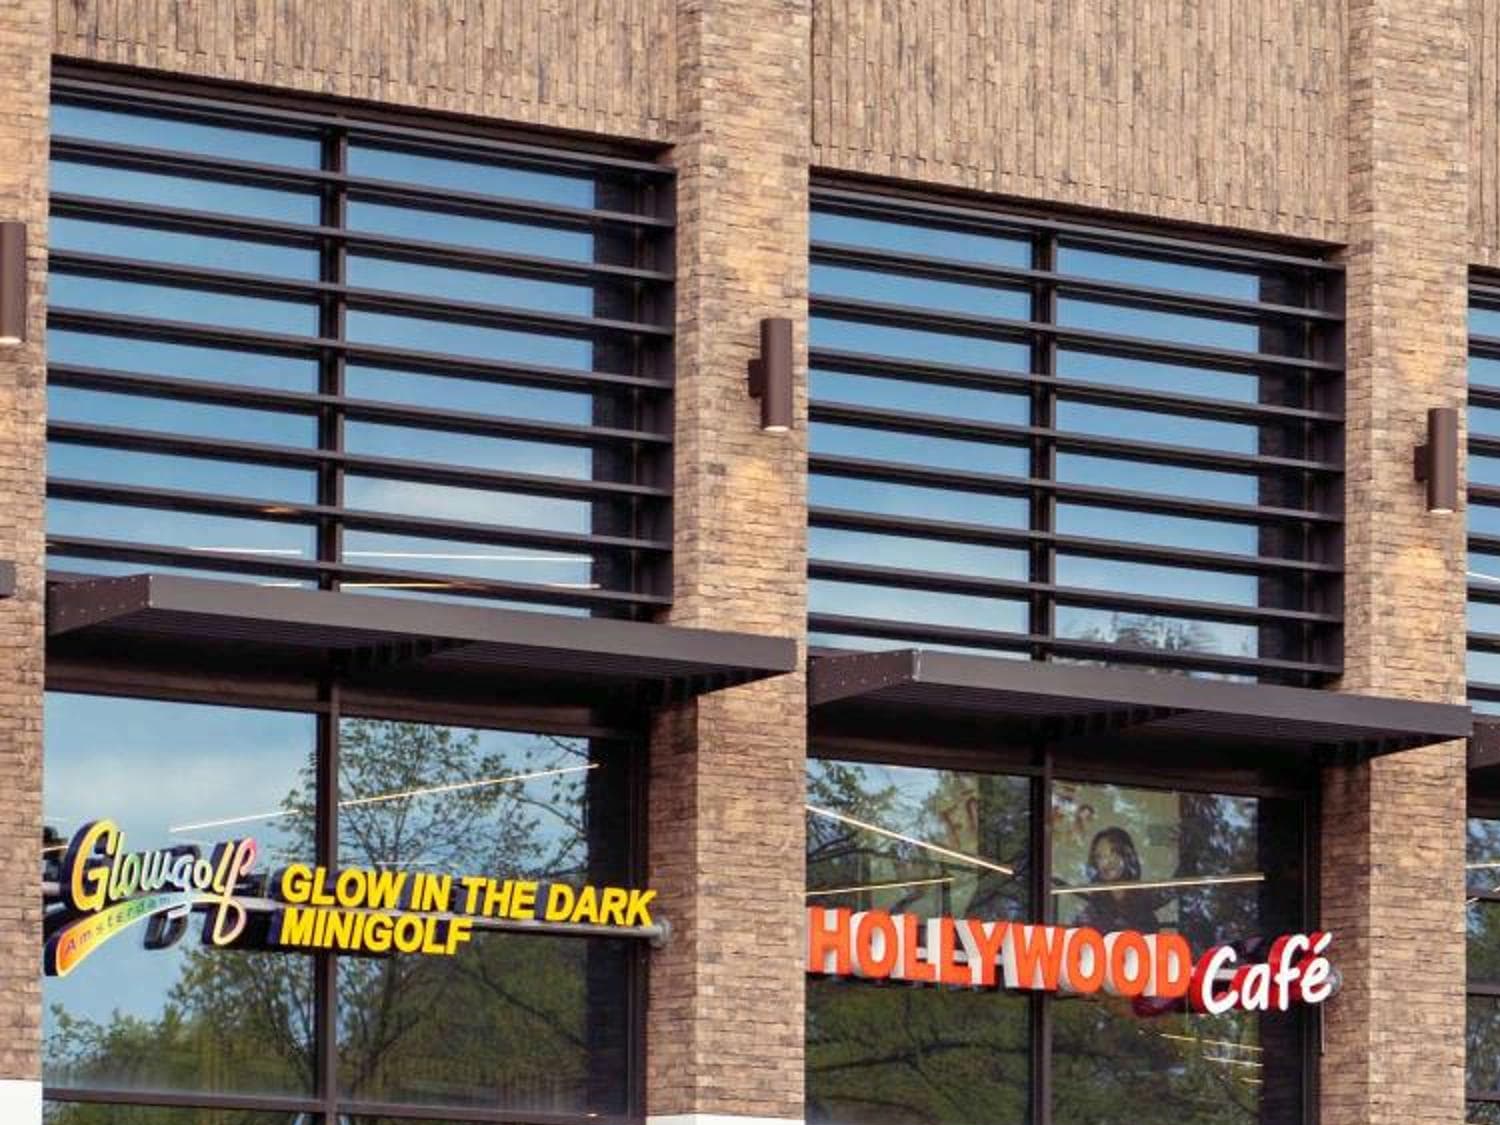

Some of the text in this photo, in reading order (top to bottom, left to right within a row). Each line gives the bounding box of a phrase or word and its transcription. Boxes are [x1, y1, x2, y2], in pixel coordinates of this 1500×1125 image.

[71, 819, 258, 946] Glowgolf
[281, 863, 657, 928] GLOW IN THE DARK
[279, 907, 474, 956] MINIGOLF
[804, 906, 1334, 1016] HOLLYWOOD Café
